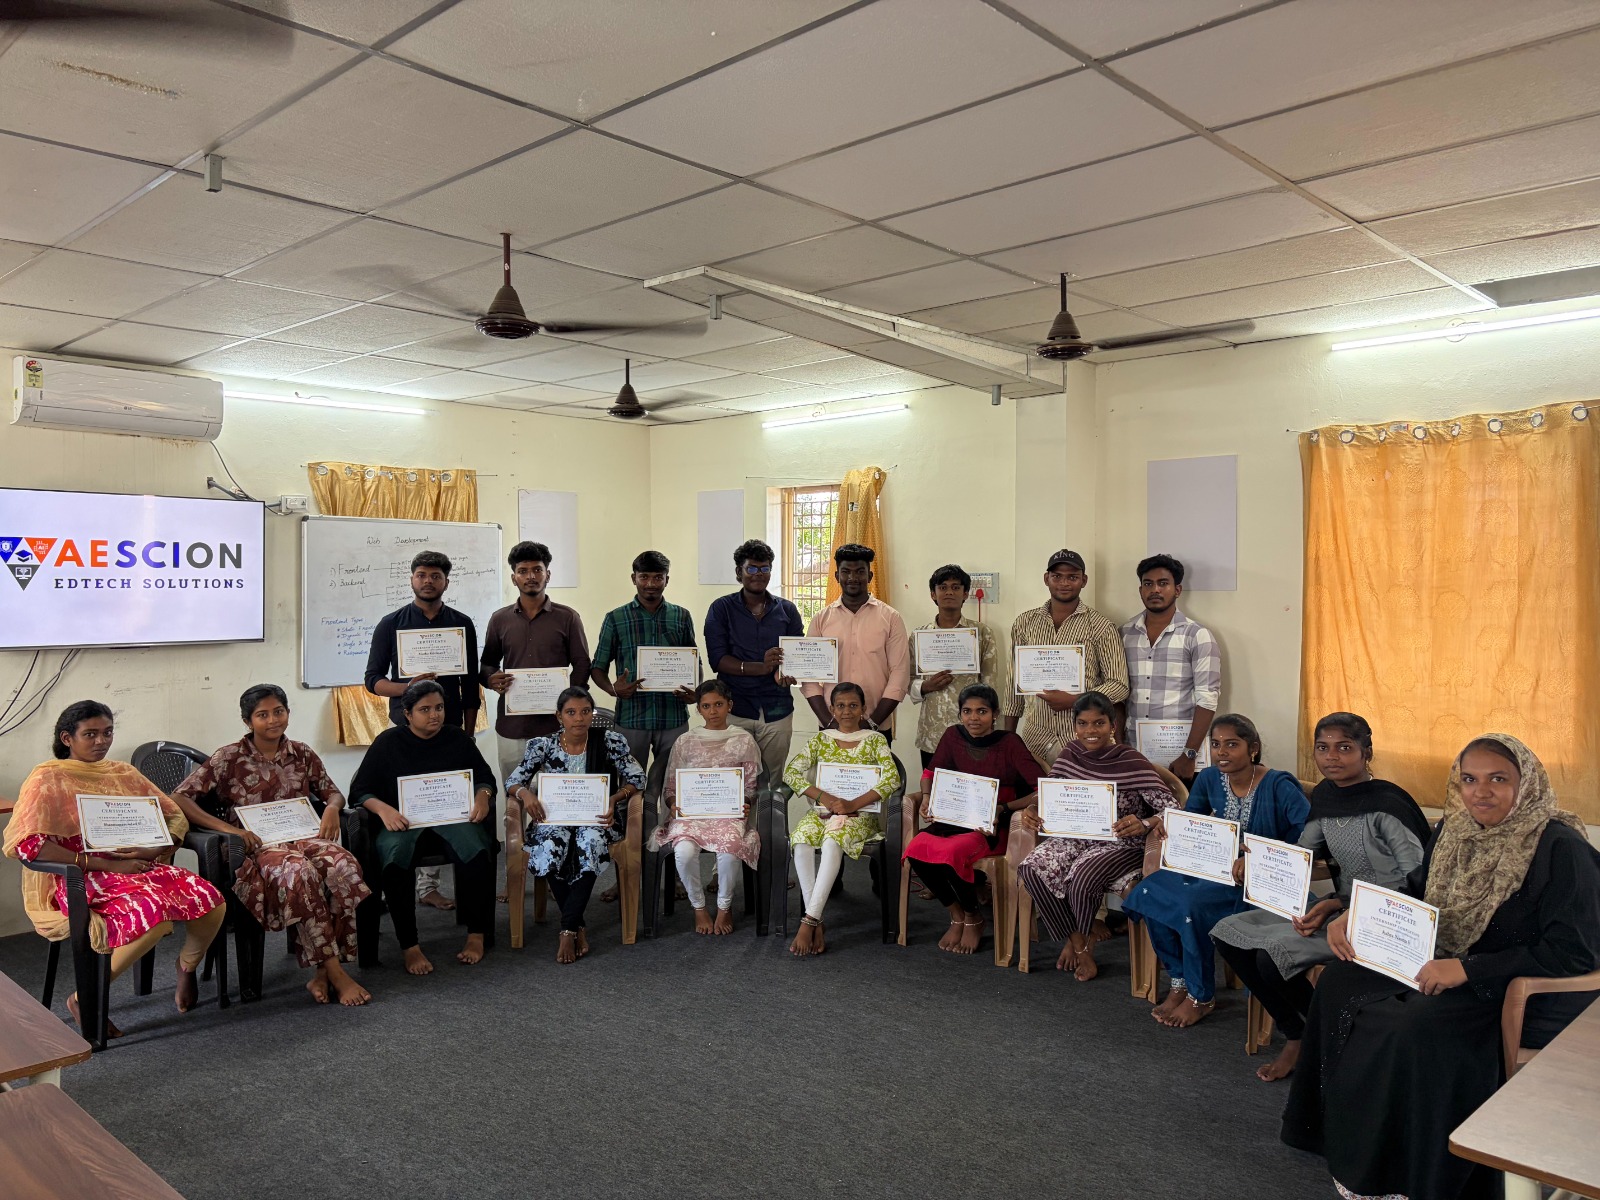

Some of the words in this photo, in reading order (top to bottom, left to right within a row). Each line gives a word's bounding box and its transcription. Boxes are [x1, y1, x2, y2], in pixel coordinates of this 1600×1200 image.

[54, 539, 242, 568] AESCION
[1054, 551, 1075, 560] KING
[339, 564, 370, 574] Frontend
[54, 578, 132, 588] EDTECH
[143, 578, 244, 589] SOLUTIONS
[340, 578, 365, 587] Backend
[1184, 827, 1217, 837] CERTIFICATE
[1263, 855, 1292, 867] CERTIFICATE
[1391, 901, 1413, 913] AESCION
[1370, 916, 1396, 928] INTERNSHIP
[1379, 908, 1416, 926] CERTIFICATE
